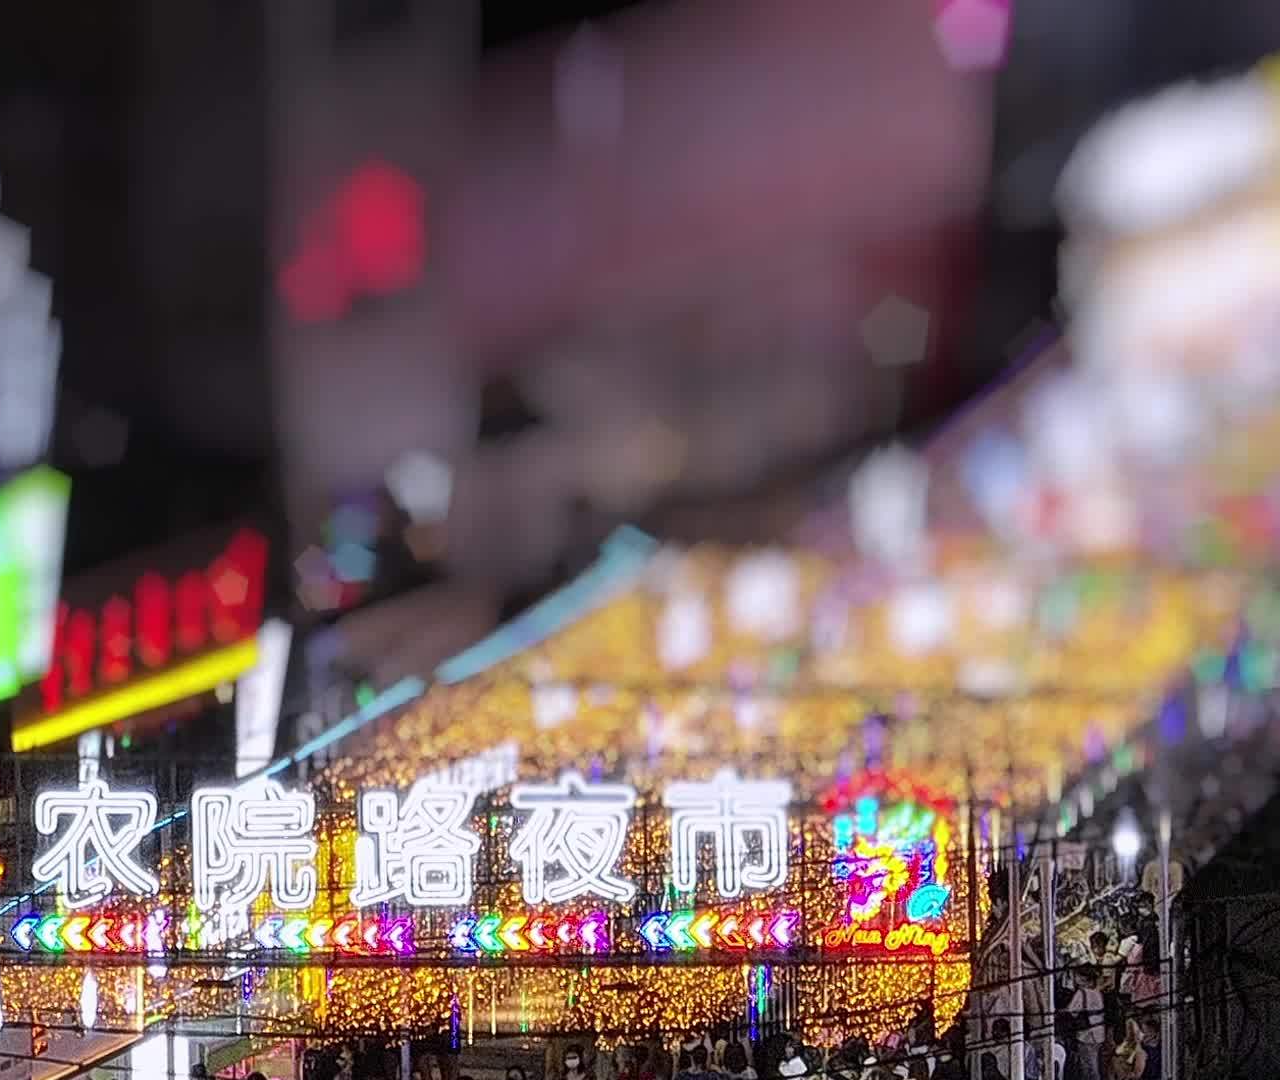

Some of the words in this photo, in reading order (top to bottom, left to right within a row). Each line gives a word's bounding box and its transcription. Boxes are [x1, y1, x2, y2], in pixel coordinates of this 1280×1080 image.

[31, 770, 793, 909] 农院路夜市
